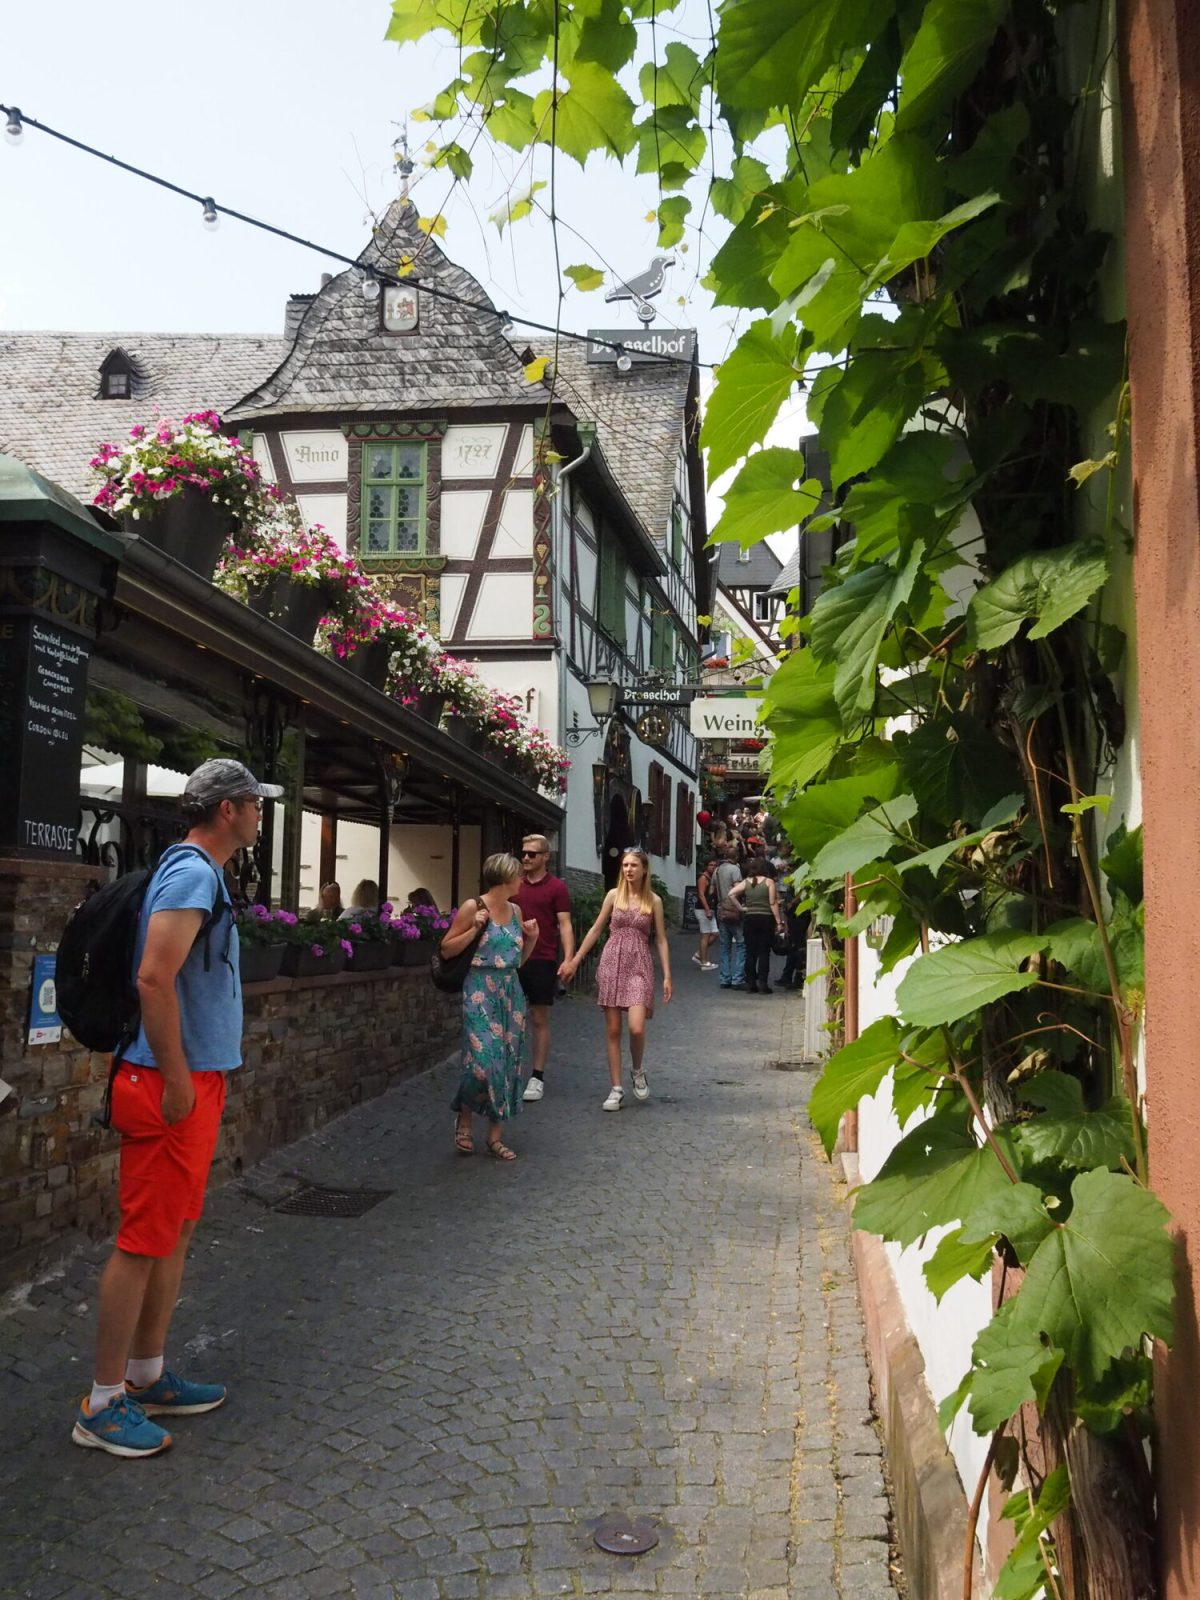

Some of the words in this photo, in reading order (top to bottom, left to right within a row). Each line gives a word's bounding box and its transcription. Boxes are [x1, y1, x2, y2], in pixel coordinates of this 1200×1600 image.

[592, 336, 686, 355] Drsselhof
[294, 445, 339, 464] Anno
[624, 688, 681, 701] Drsselhof
[703, 714, 771, 738] Weing
[24, 819, 76, 851] TERRASSE
